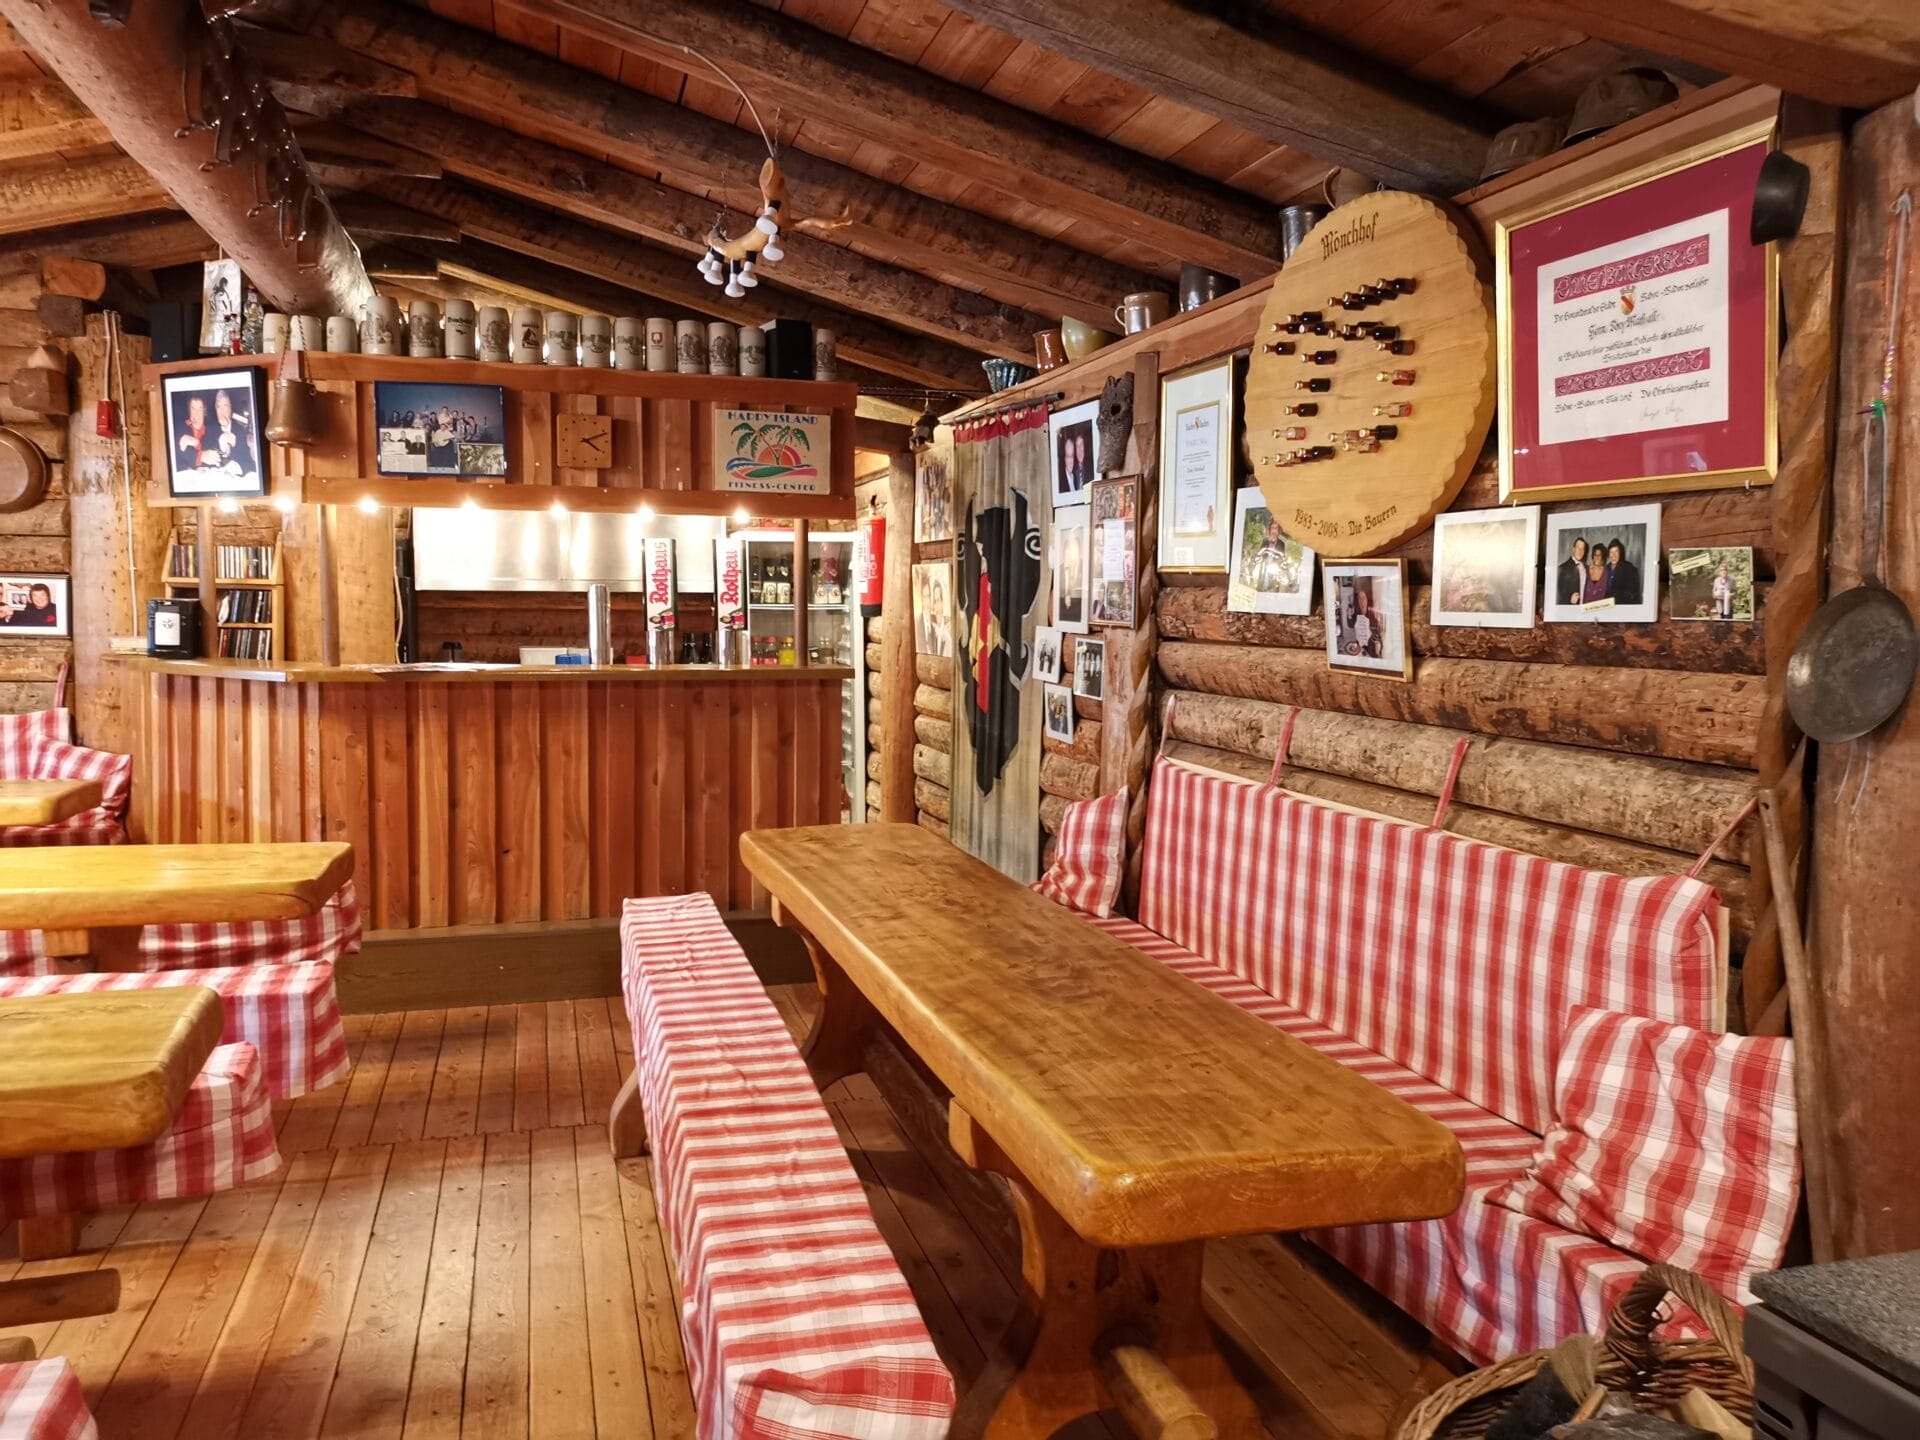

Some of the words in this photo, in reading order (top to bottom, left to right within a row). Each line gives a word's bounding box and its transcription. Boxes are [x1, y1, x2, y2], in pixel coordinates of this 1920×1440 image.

[1321, 212, 1379, 261] Mönchhof
[728, 411, 770, 422] HAPPY
[774, 414, 817, 425] ISLAND
[1347, 520, 1362, 537] Die
[649, 542, 672, 606] Rothaus
[720, 549, 742, 606] Rothau
